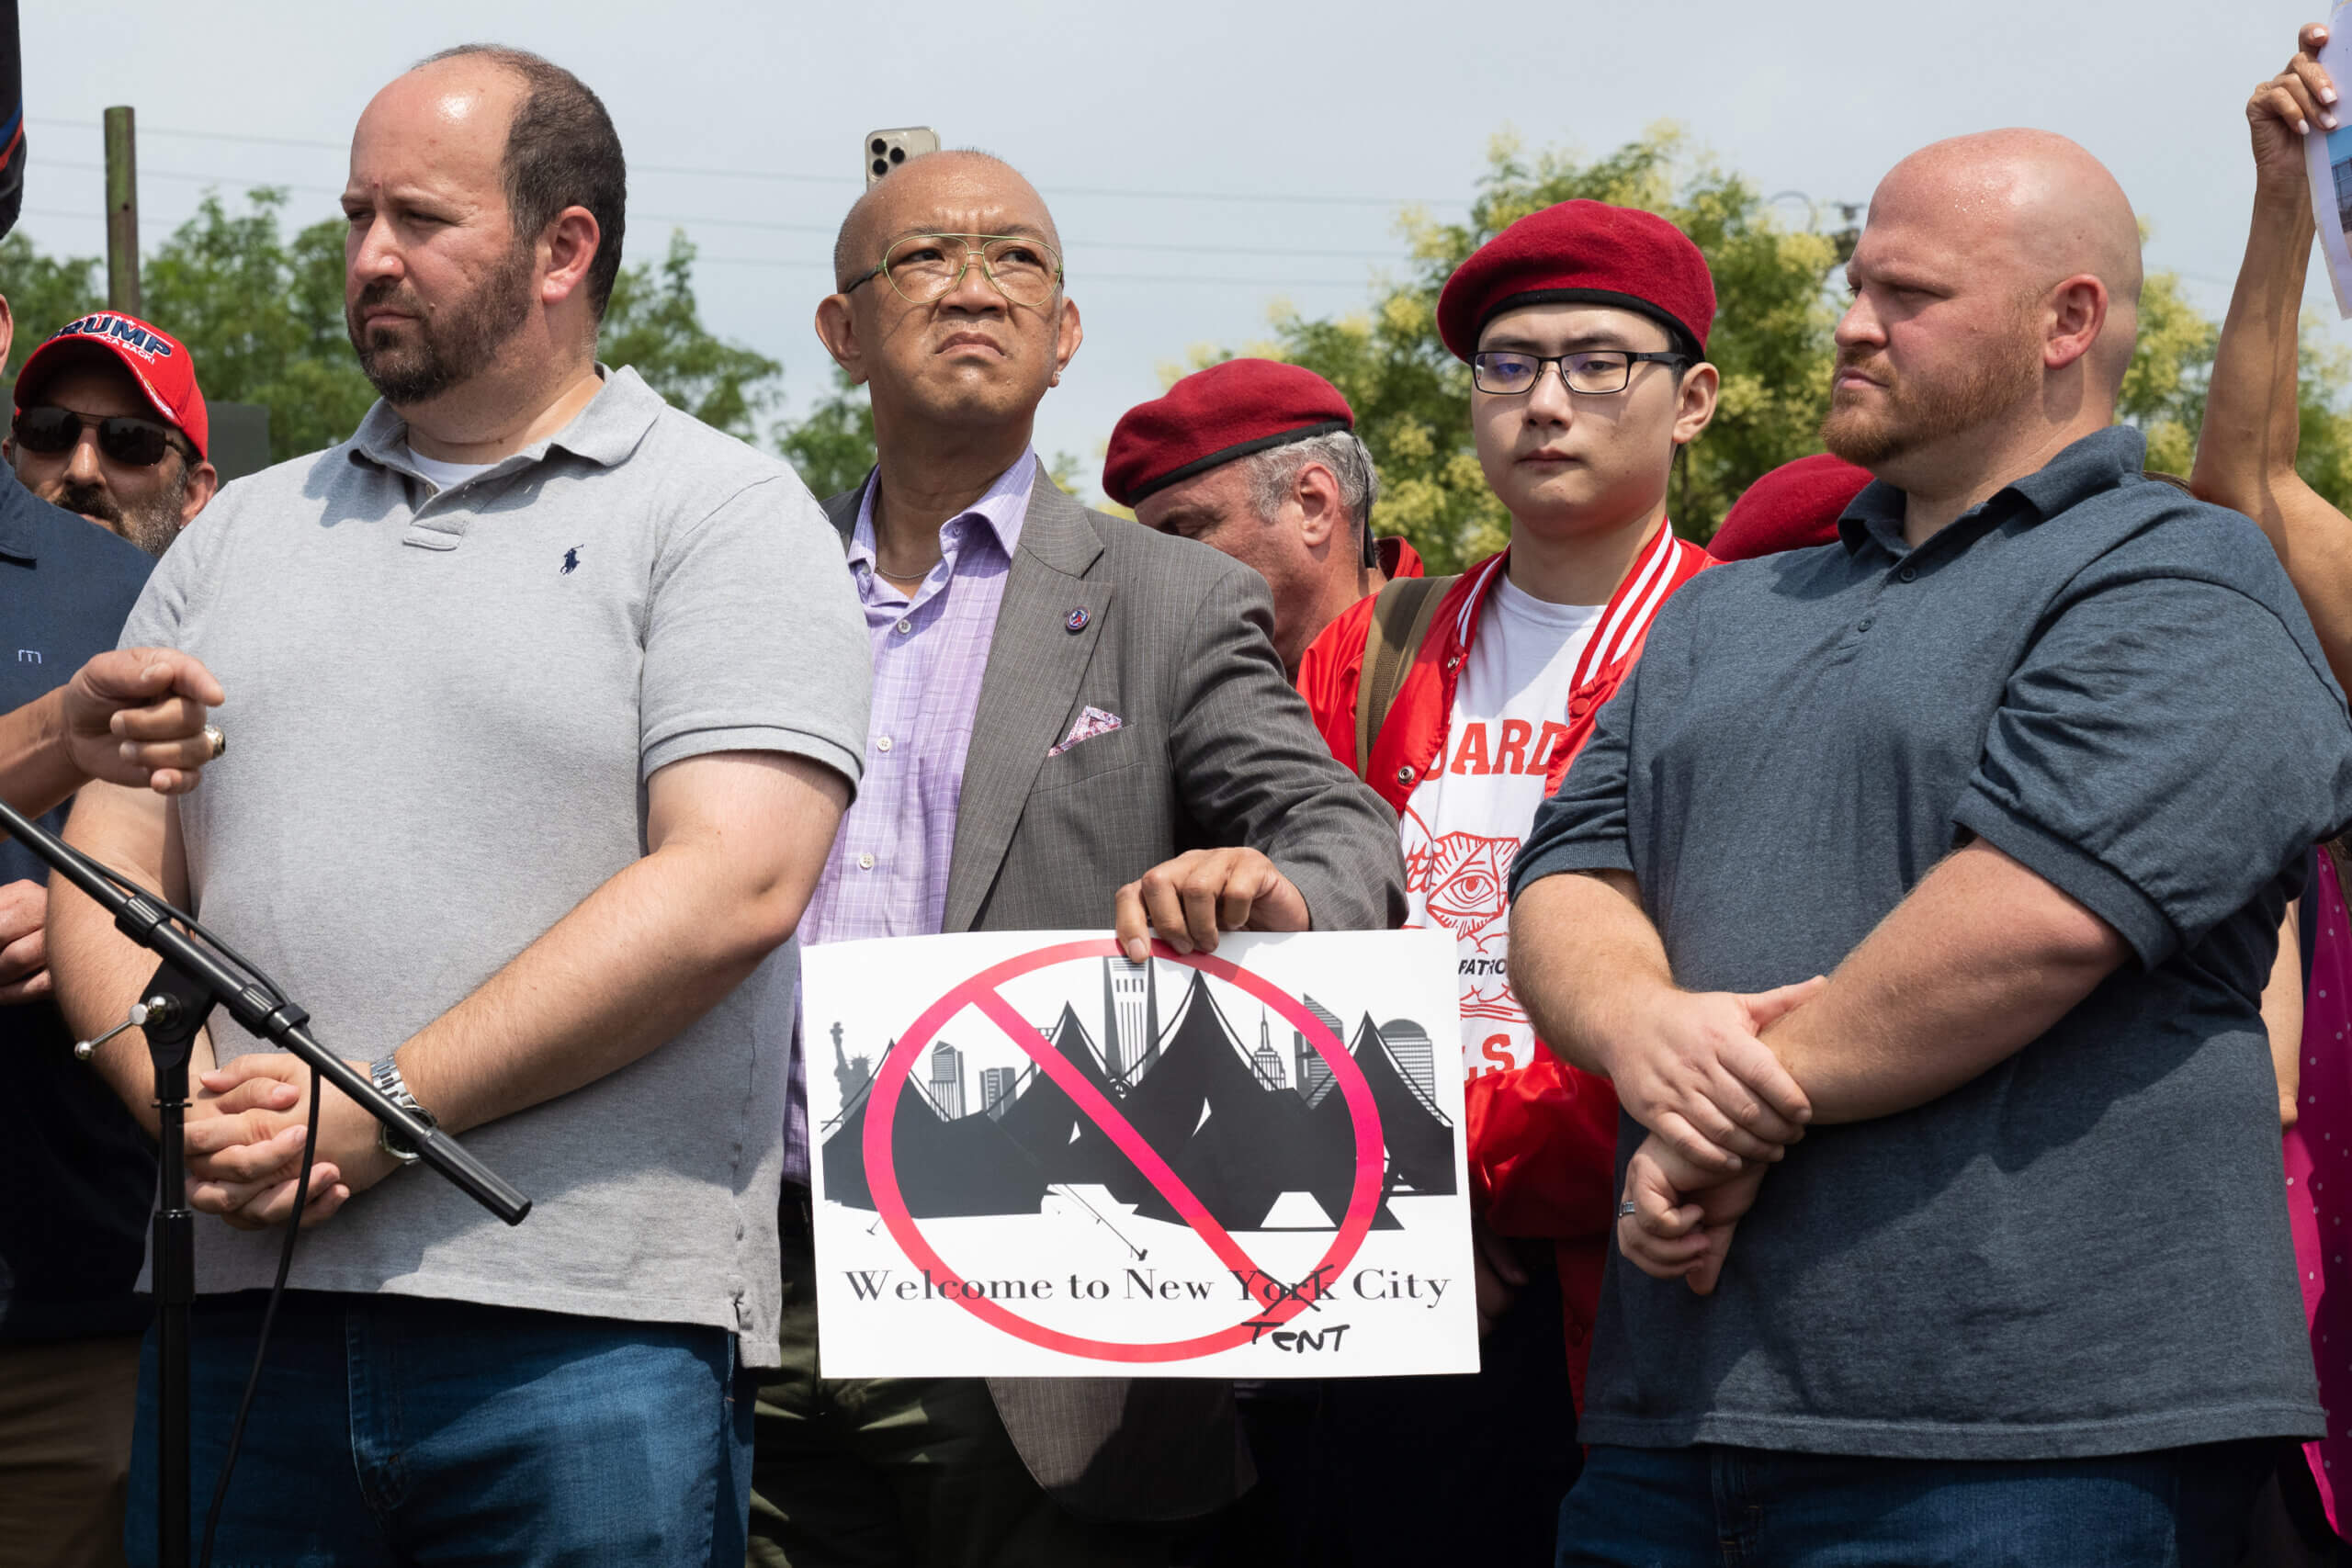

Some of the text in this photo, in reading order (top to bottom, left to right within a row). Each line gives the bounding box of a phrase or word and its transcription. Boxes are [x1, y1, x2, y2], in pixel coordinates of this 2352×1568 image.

[841, 1269, 1453, 1308] Welcome to New York City
